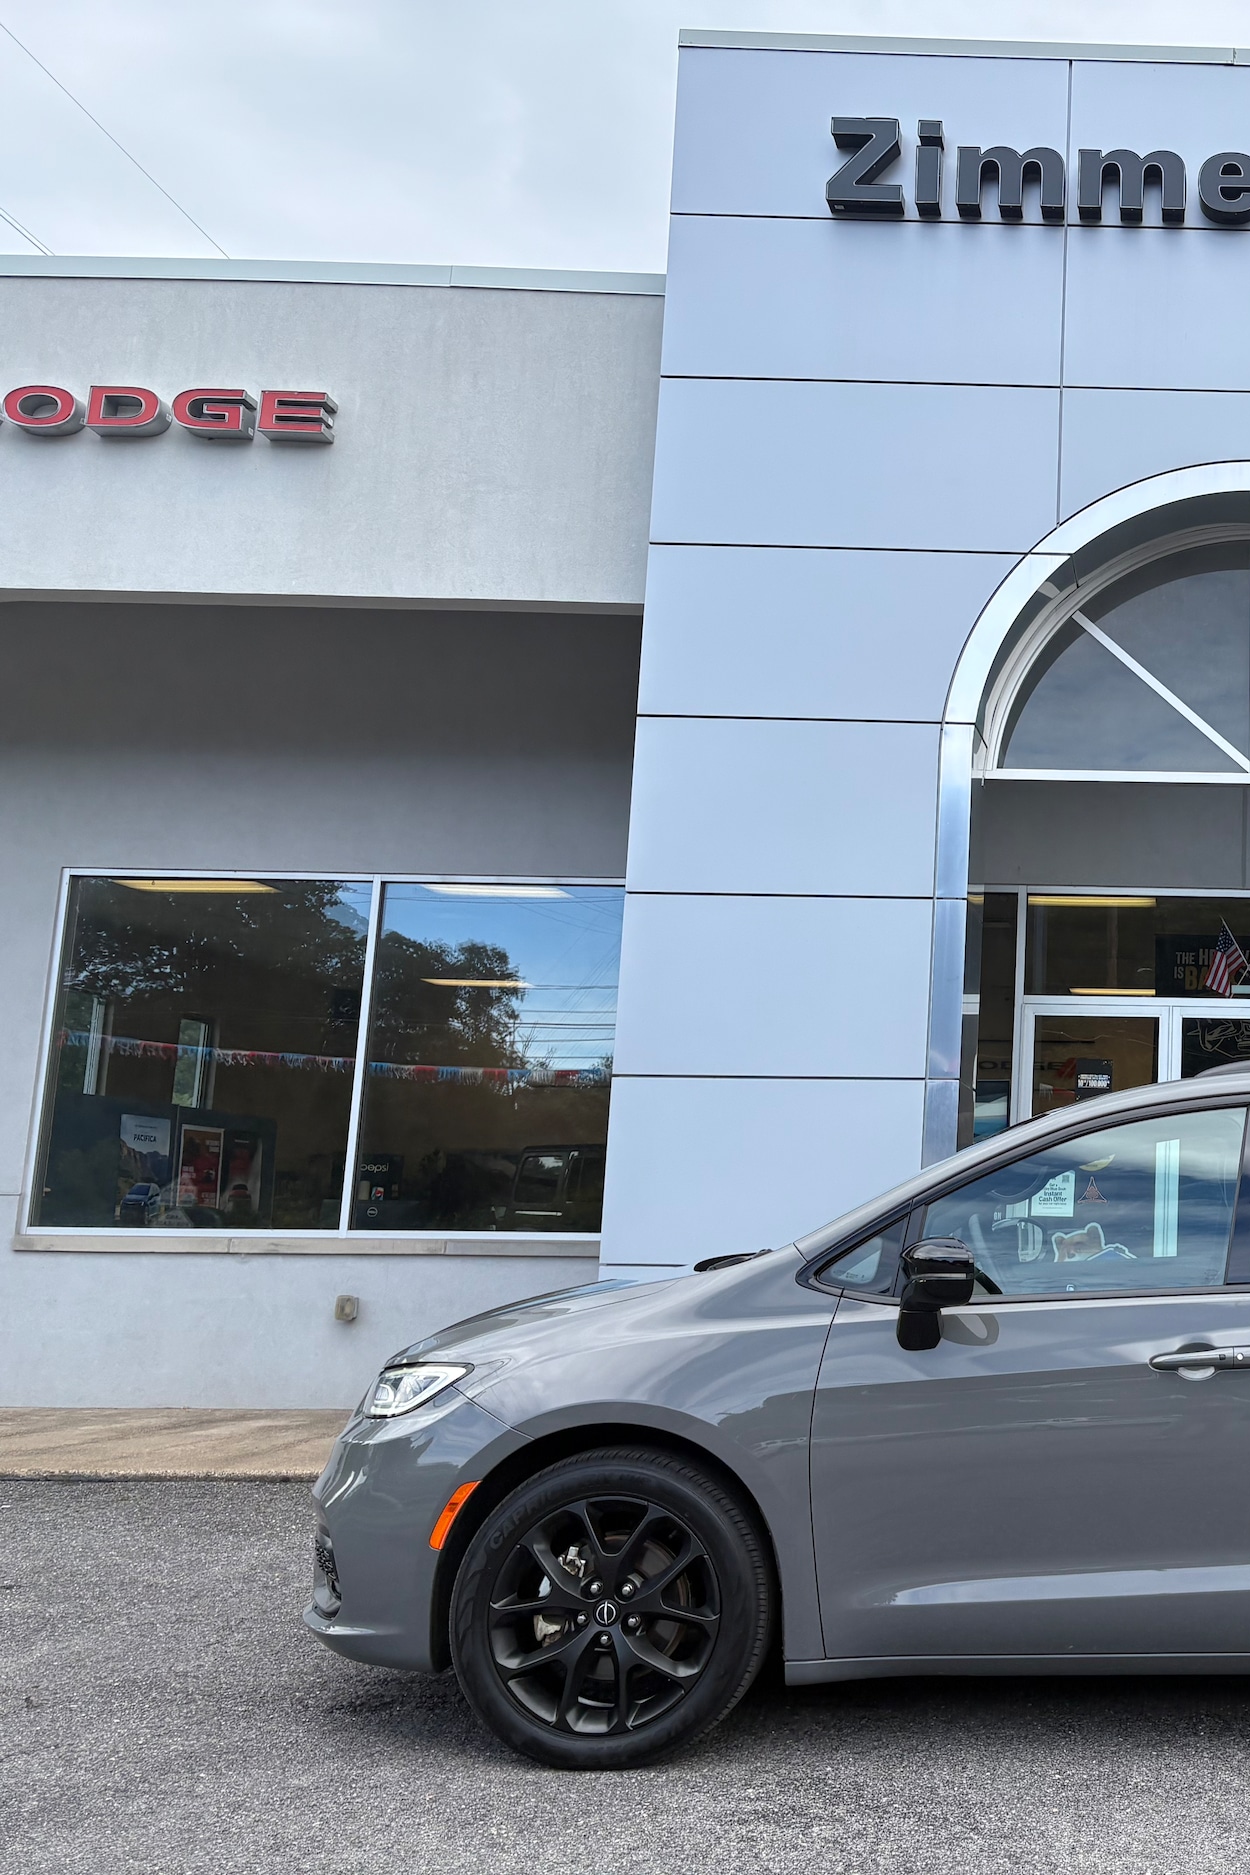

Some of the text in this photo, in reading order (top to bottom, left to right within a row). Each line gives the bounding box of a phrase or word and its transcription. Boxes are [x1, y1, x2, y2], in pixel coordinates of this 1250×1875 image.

[0, 385, 338, 444] ODGE
[1175, 951, 1196, 965] THE
[1173, 966, 1184, 980] IS
[133, 1133, 157, 1142] PACIFICA
